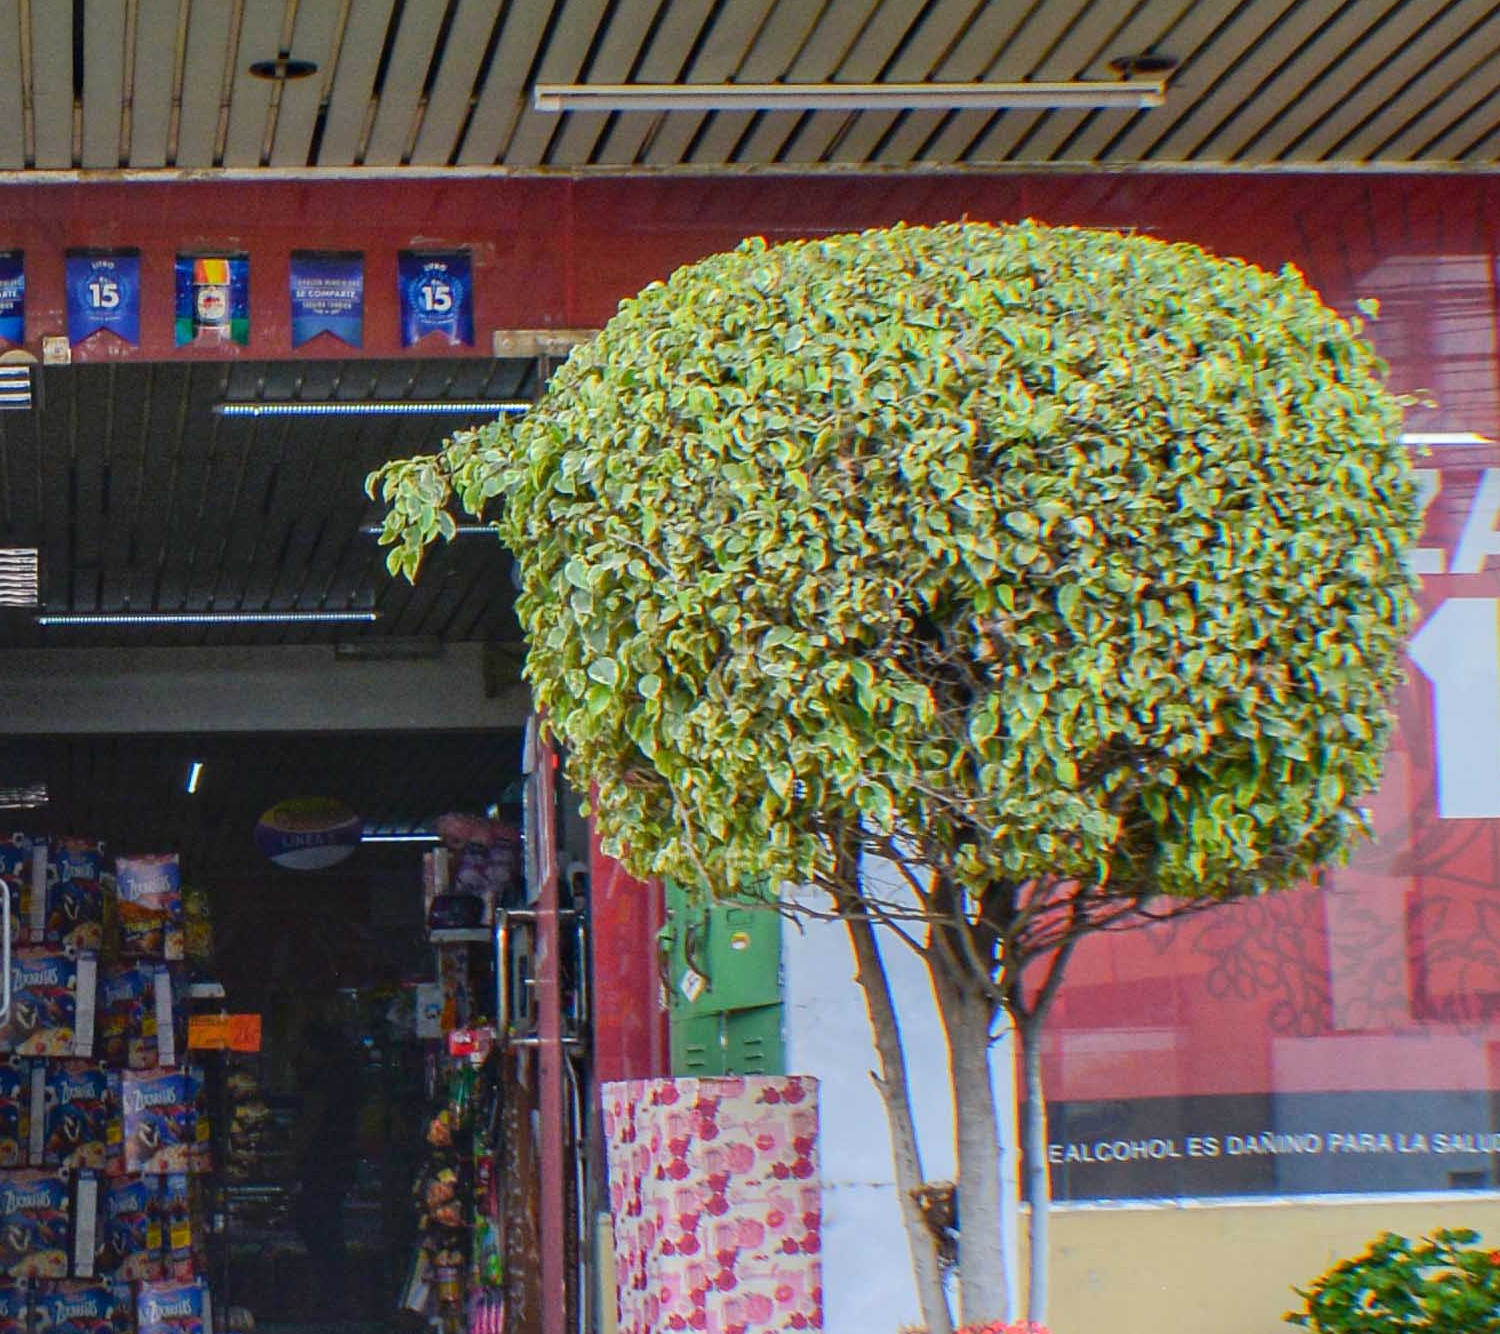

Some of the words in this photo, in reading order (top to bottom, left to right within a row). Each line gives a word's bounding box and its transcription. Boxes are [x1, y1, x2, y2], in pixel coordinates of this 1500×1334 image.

[89, 283, 120, 309] 15
[422, 286, 452, 312] 15
[1063, 1136, 1183, 1164] ALCOHOL
[1186, 1135, 1220, 1158] ES
[1225, 1131, 1323, 1156] DAÑINO
[1327, 1132, 1393, 1154] PARA
[1398, 1132, 1429, 1154] LA
